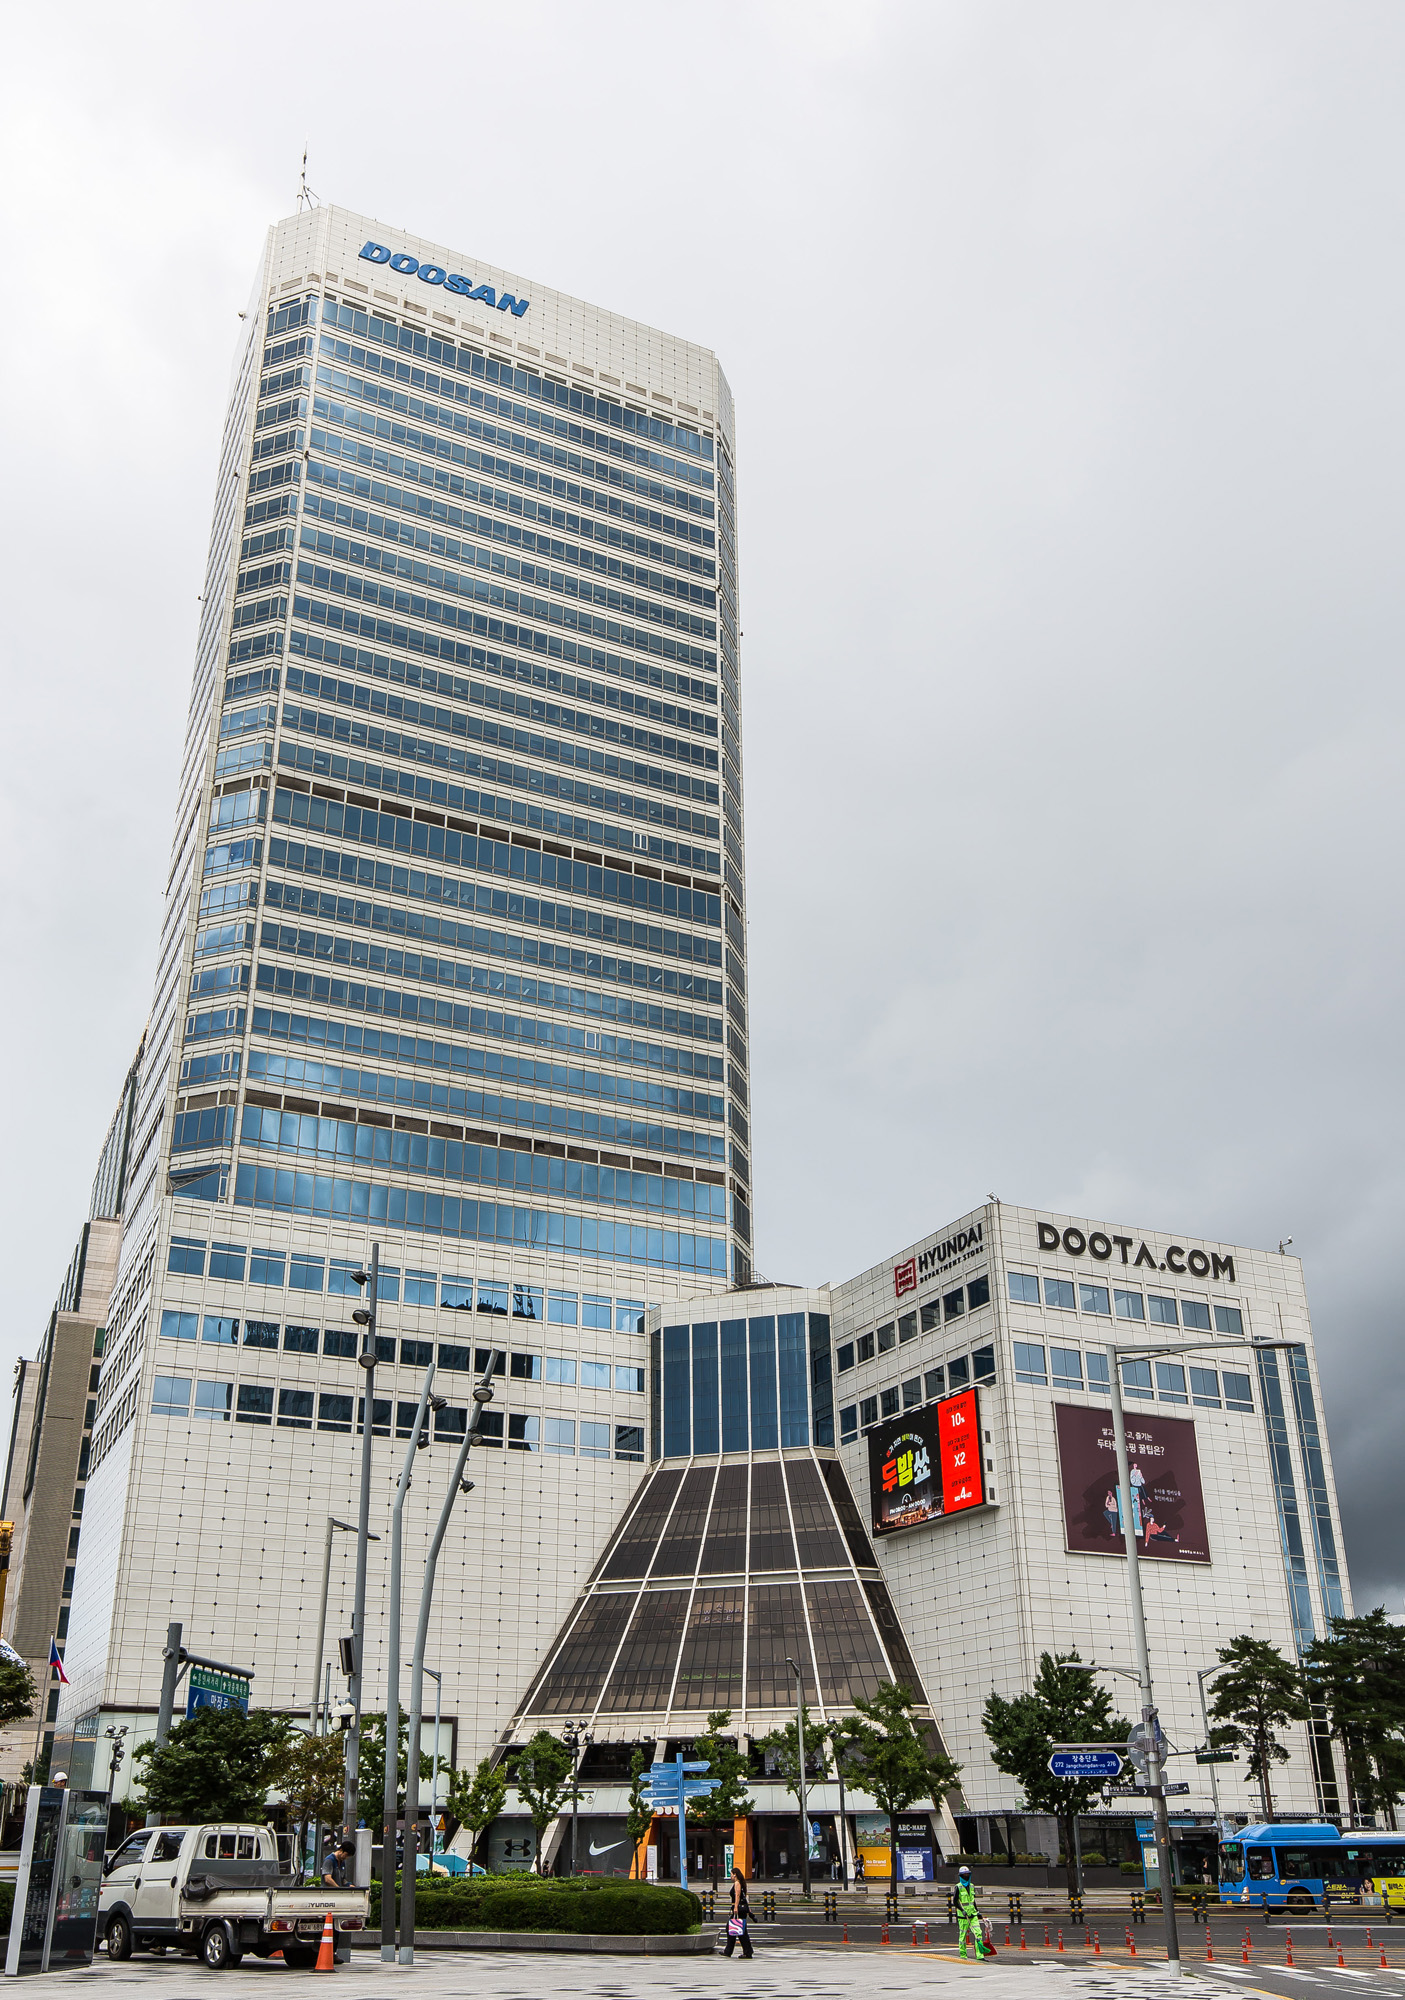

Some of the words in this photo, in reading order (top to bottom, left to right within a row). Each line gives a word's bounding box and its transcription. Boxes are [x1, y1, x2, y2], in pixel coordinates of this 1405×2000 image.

[358, 241, 530, 318] DOOSAN
[918, 1223, 983, 1273] HYUNDAI
[1038, 1222, 1236, 1282] DOOTA.COM
[920, 1257, 961, 1283] DEPARTMENT
[963, 1245, 984, 1261] STORE
[898, 1267, 912, 1280] DUTY
[898, 1276, 912, 1289] FREE
[951, 1412, 965, 1427] 10%
[1135, 1431, 1153, 1442] 즐기는
[1138, 1443, 1165, 1456] 꿀팁은?
[954, 1451, 966, 1467] X2
[210, 1694, 229, 1710] 마장로
[1072, 1755, 1098, 1763] 장충단로
[1326, 1883, 1348, 1891] 스트레스
